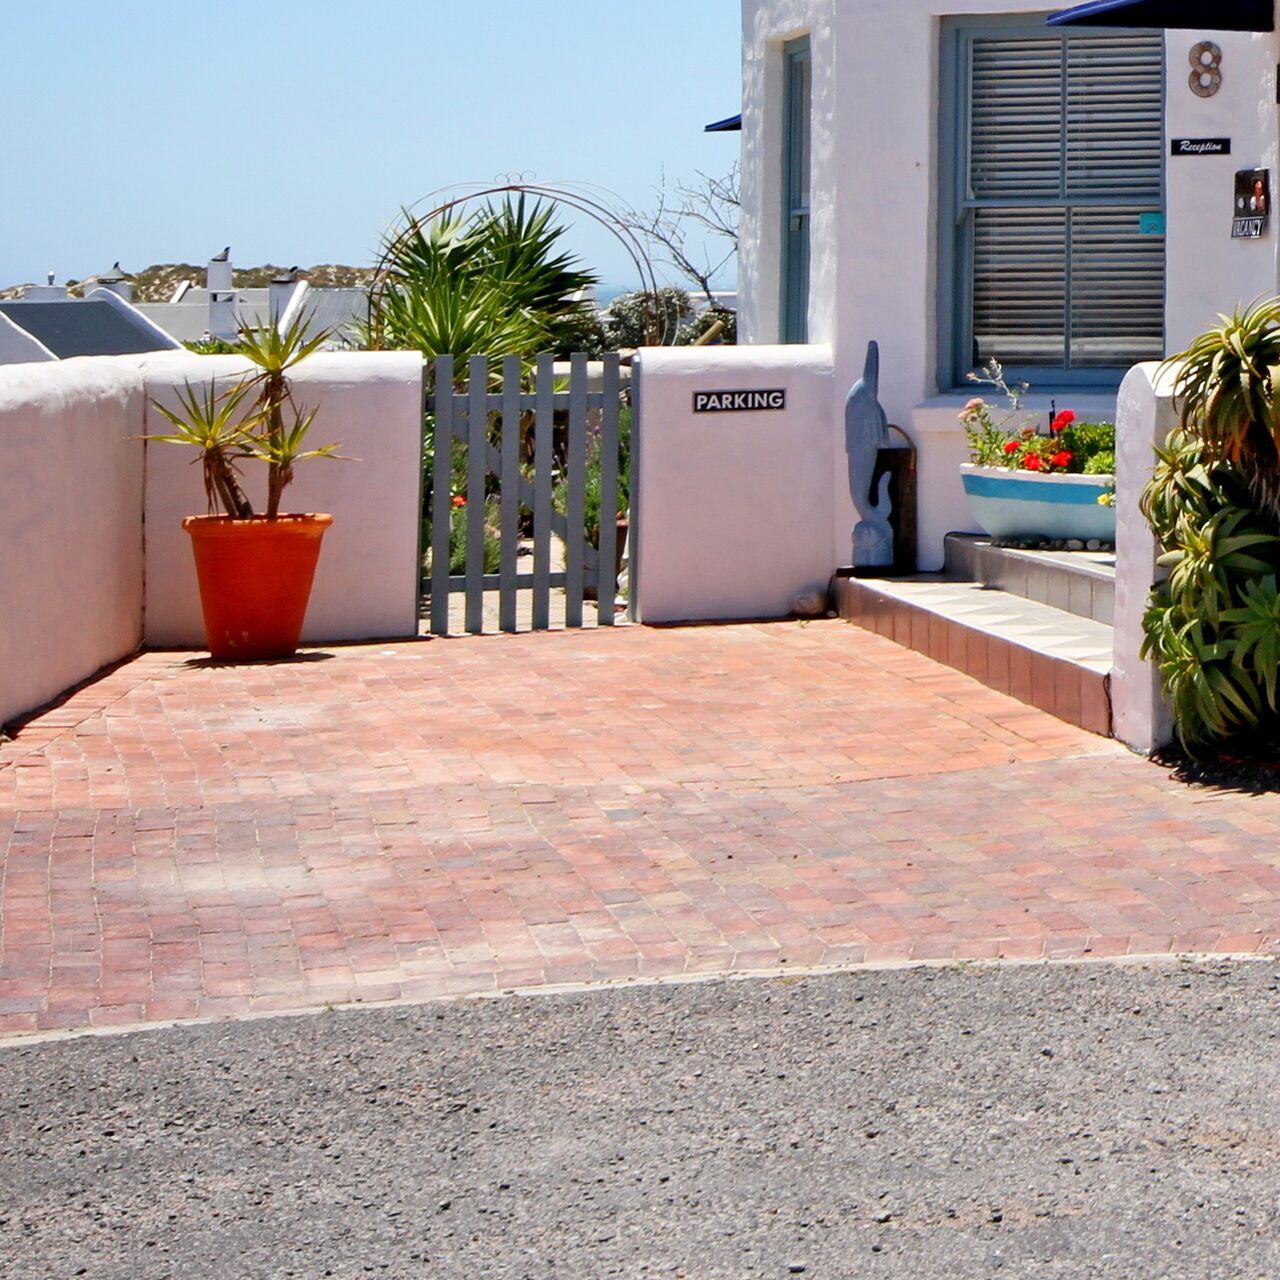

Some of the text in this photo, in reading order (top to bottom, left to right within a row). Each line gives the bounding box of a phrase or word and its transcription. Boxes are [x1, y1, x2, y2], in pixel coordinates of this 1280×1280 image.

[1188, 40, 1222, 98] 8
[1180, 140, 1222, 153] Reception
[1232, 219, 1263, 237] VACANCY
[697, 392, 784, 410] PARKING
